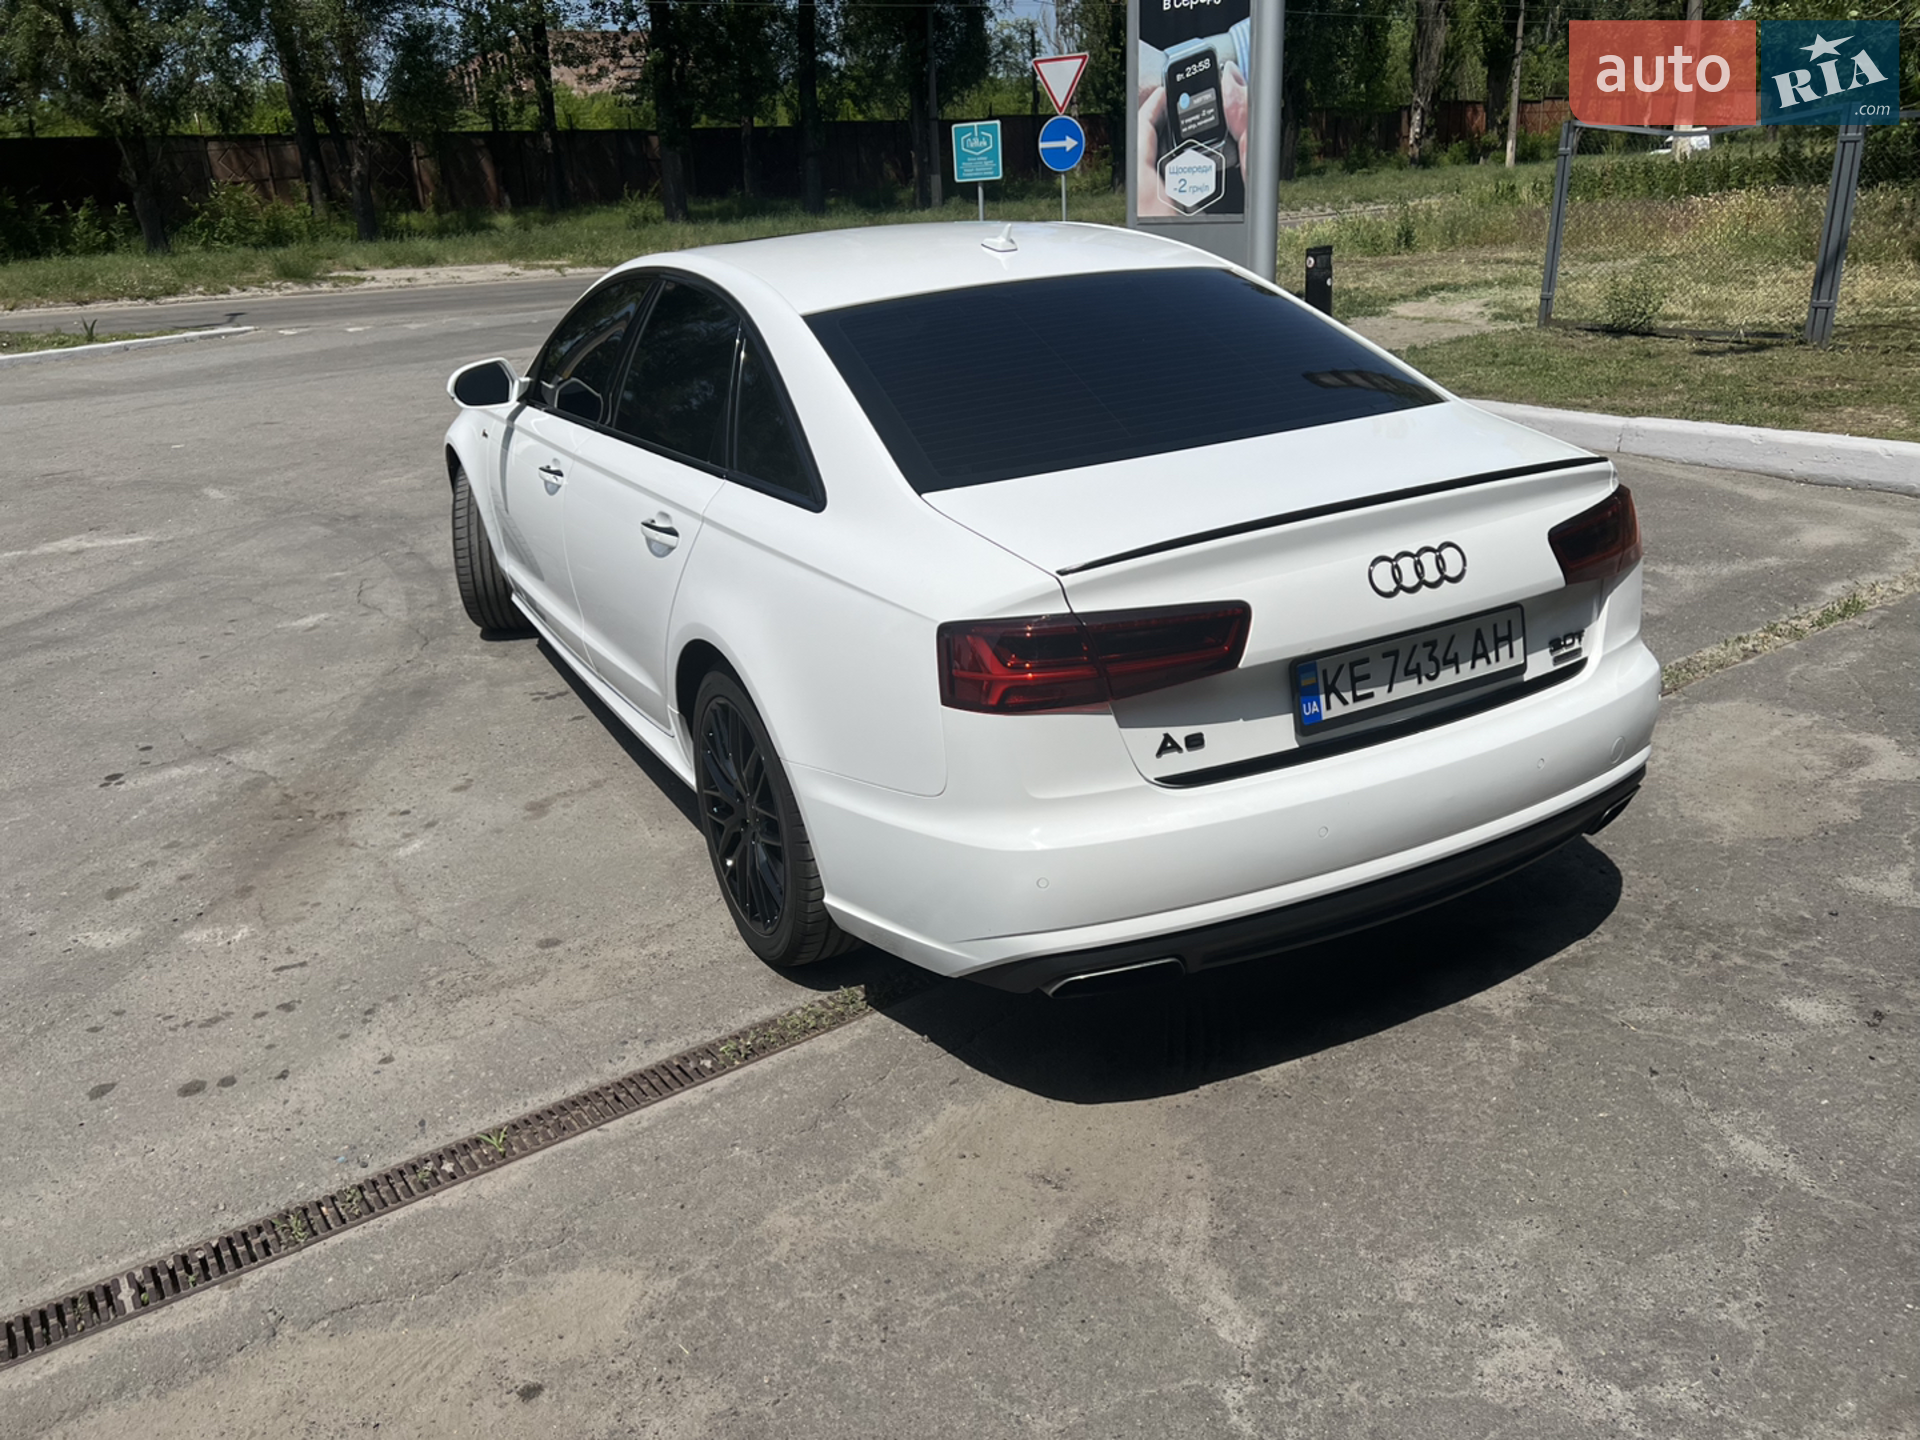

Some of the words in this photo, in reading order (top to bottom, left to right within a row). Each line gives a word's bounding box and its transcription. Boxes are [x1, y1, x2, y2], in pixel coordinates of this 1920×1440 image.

[1321, 656, 1375, 711] KE
[1381, 633, 1461, 694] 7434
[1470, 619, 1515, 670] AH
[1303, 703, 1320, 716] UA
